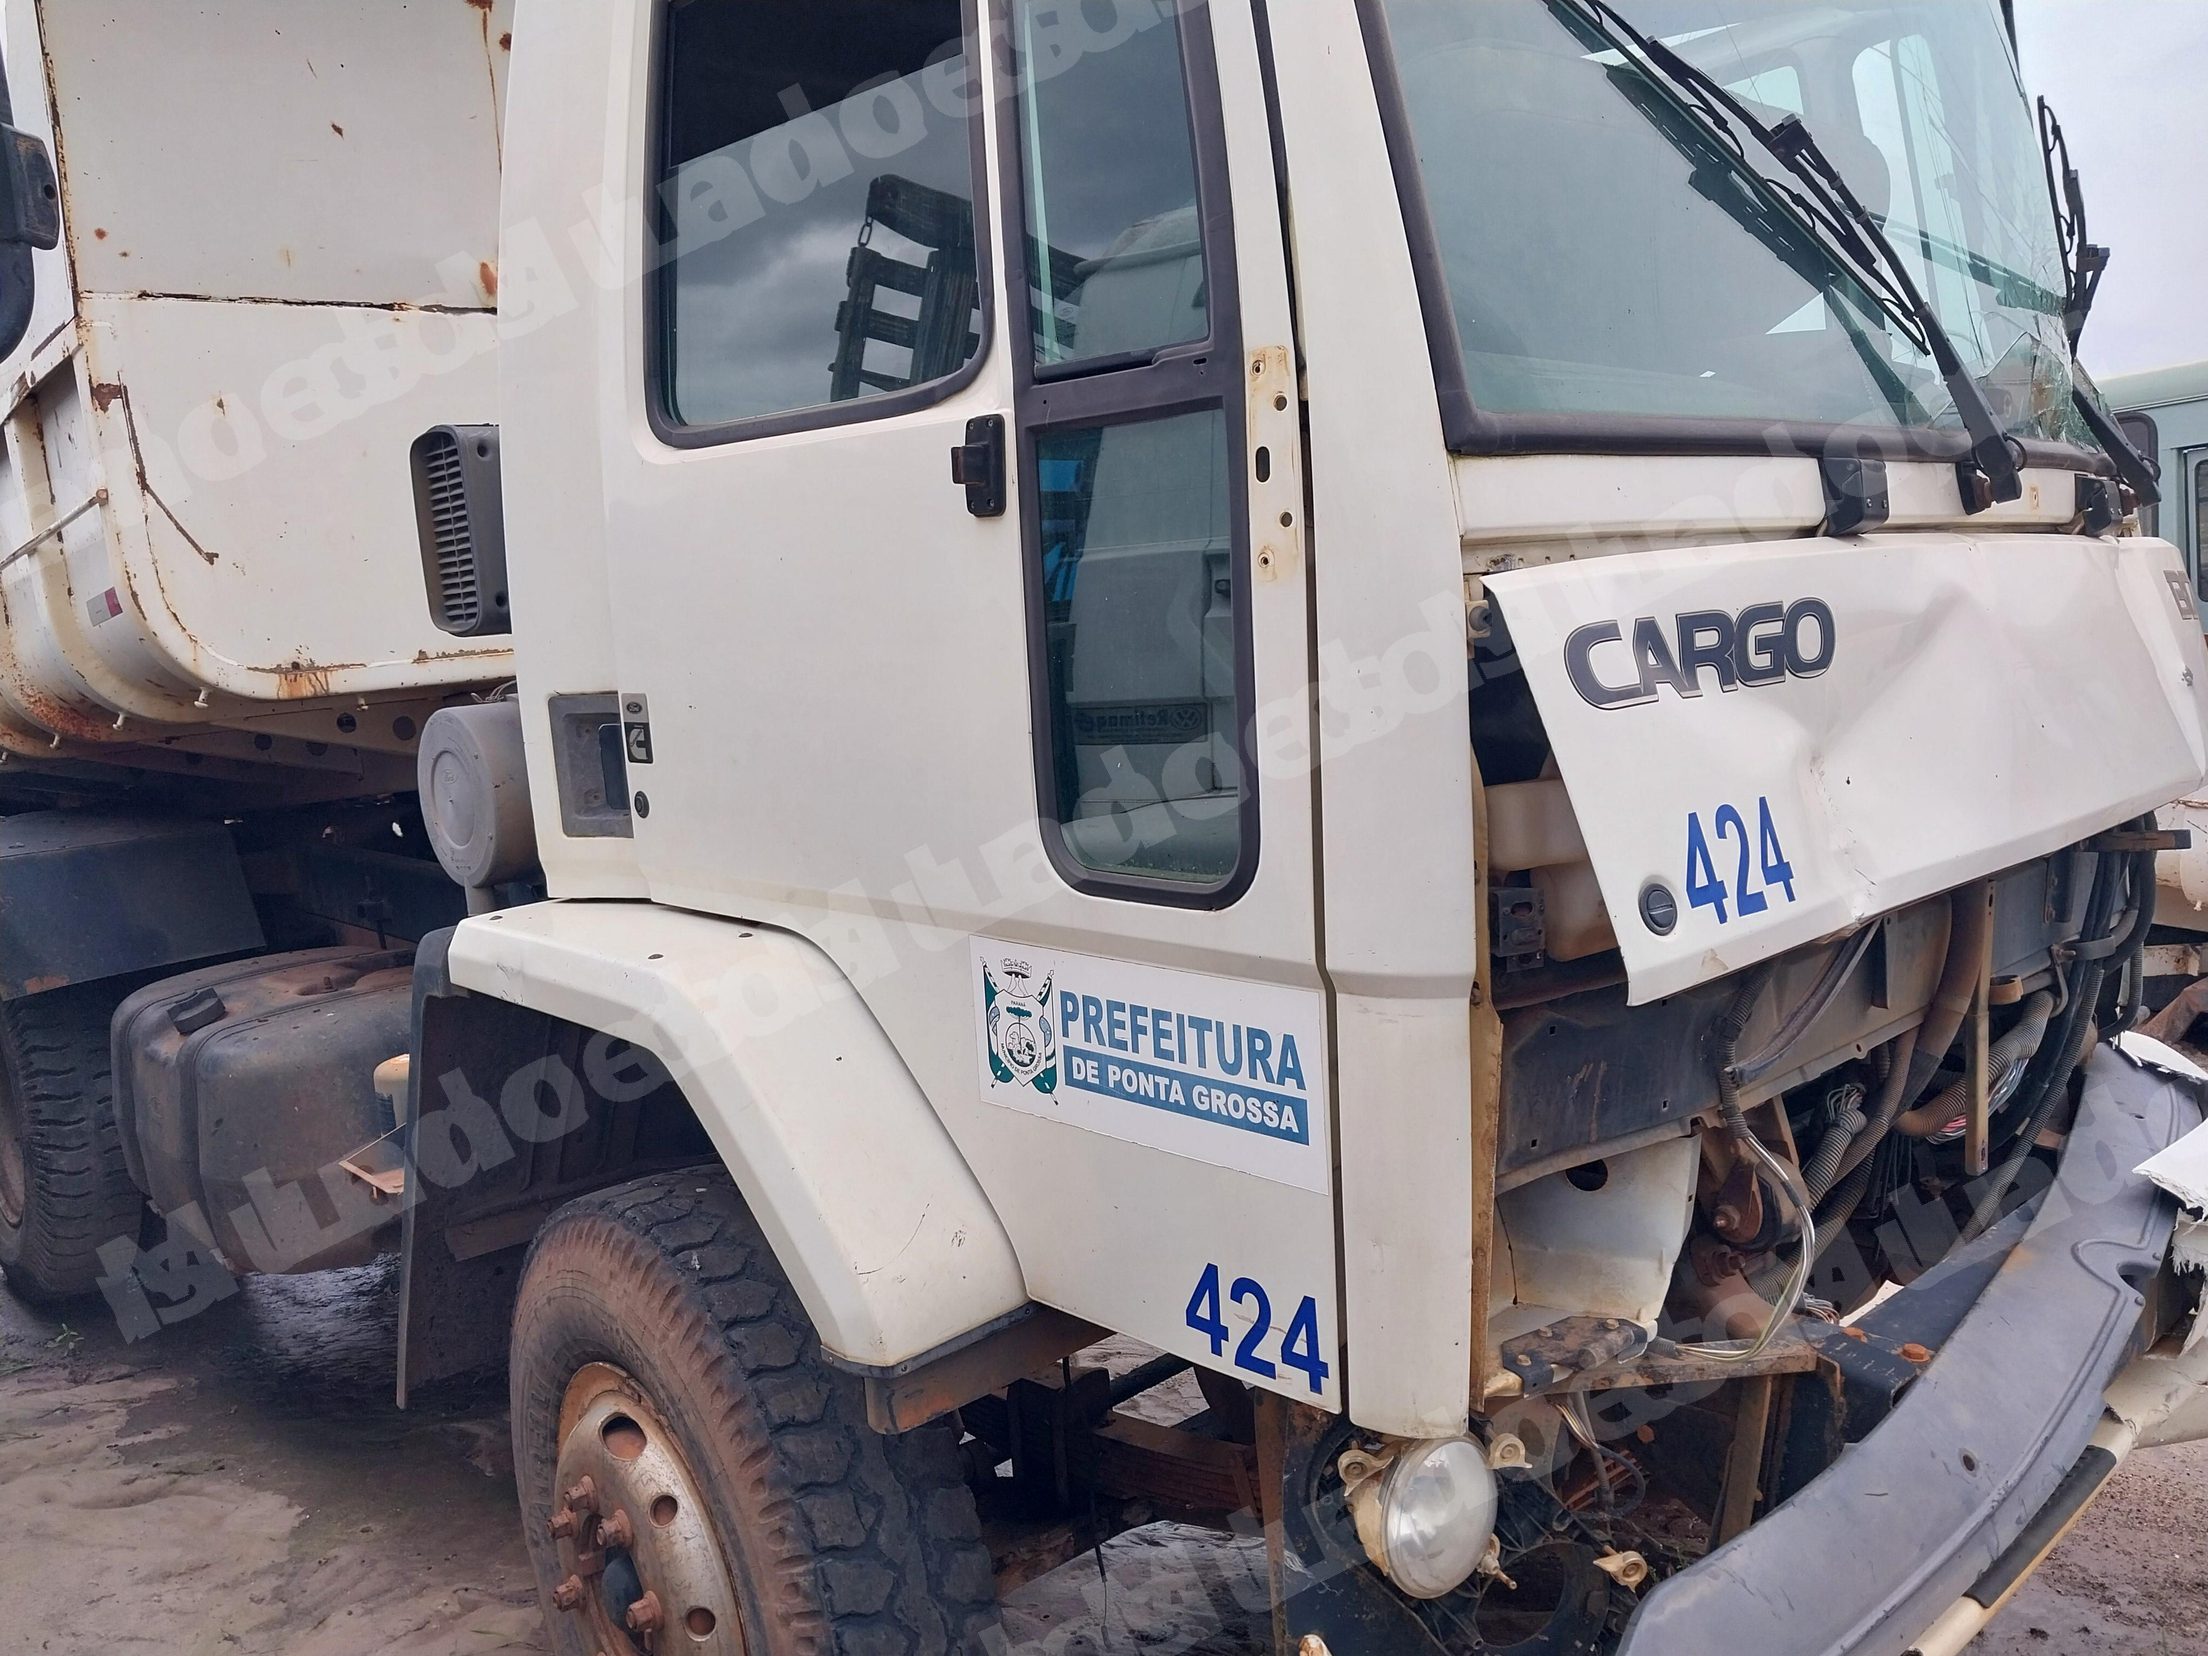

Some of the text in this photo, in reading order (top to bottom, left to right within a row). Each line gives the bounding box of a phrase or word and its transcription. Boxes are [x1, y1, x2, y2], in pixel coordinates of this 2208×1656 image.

[1563, 597, 1836, 710] CARGO
[1686, 796, 1796, 924] 424
[1060, 990, 1307, 1090] PREFEITURA
[1072, 1056, 1300, 1133] DE PONTA GROSSA
[1186, 1263, 1329, 1395] 424
